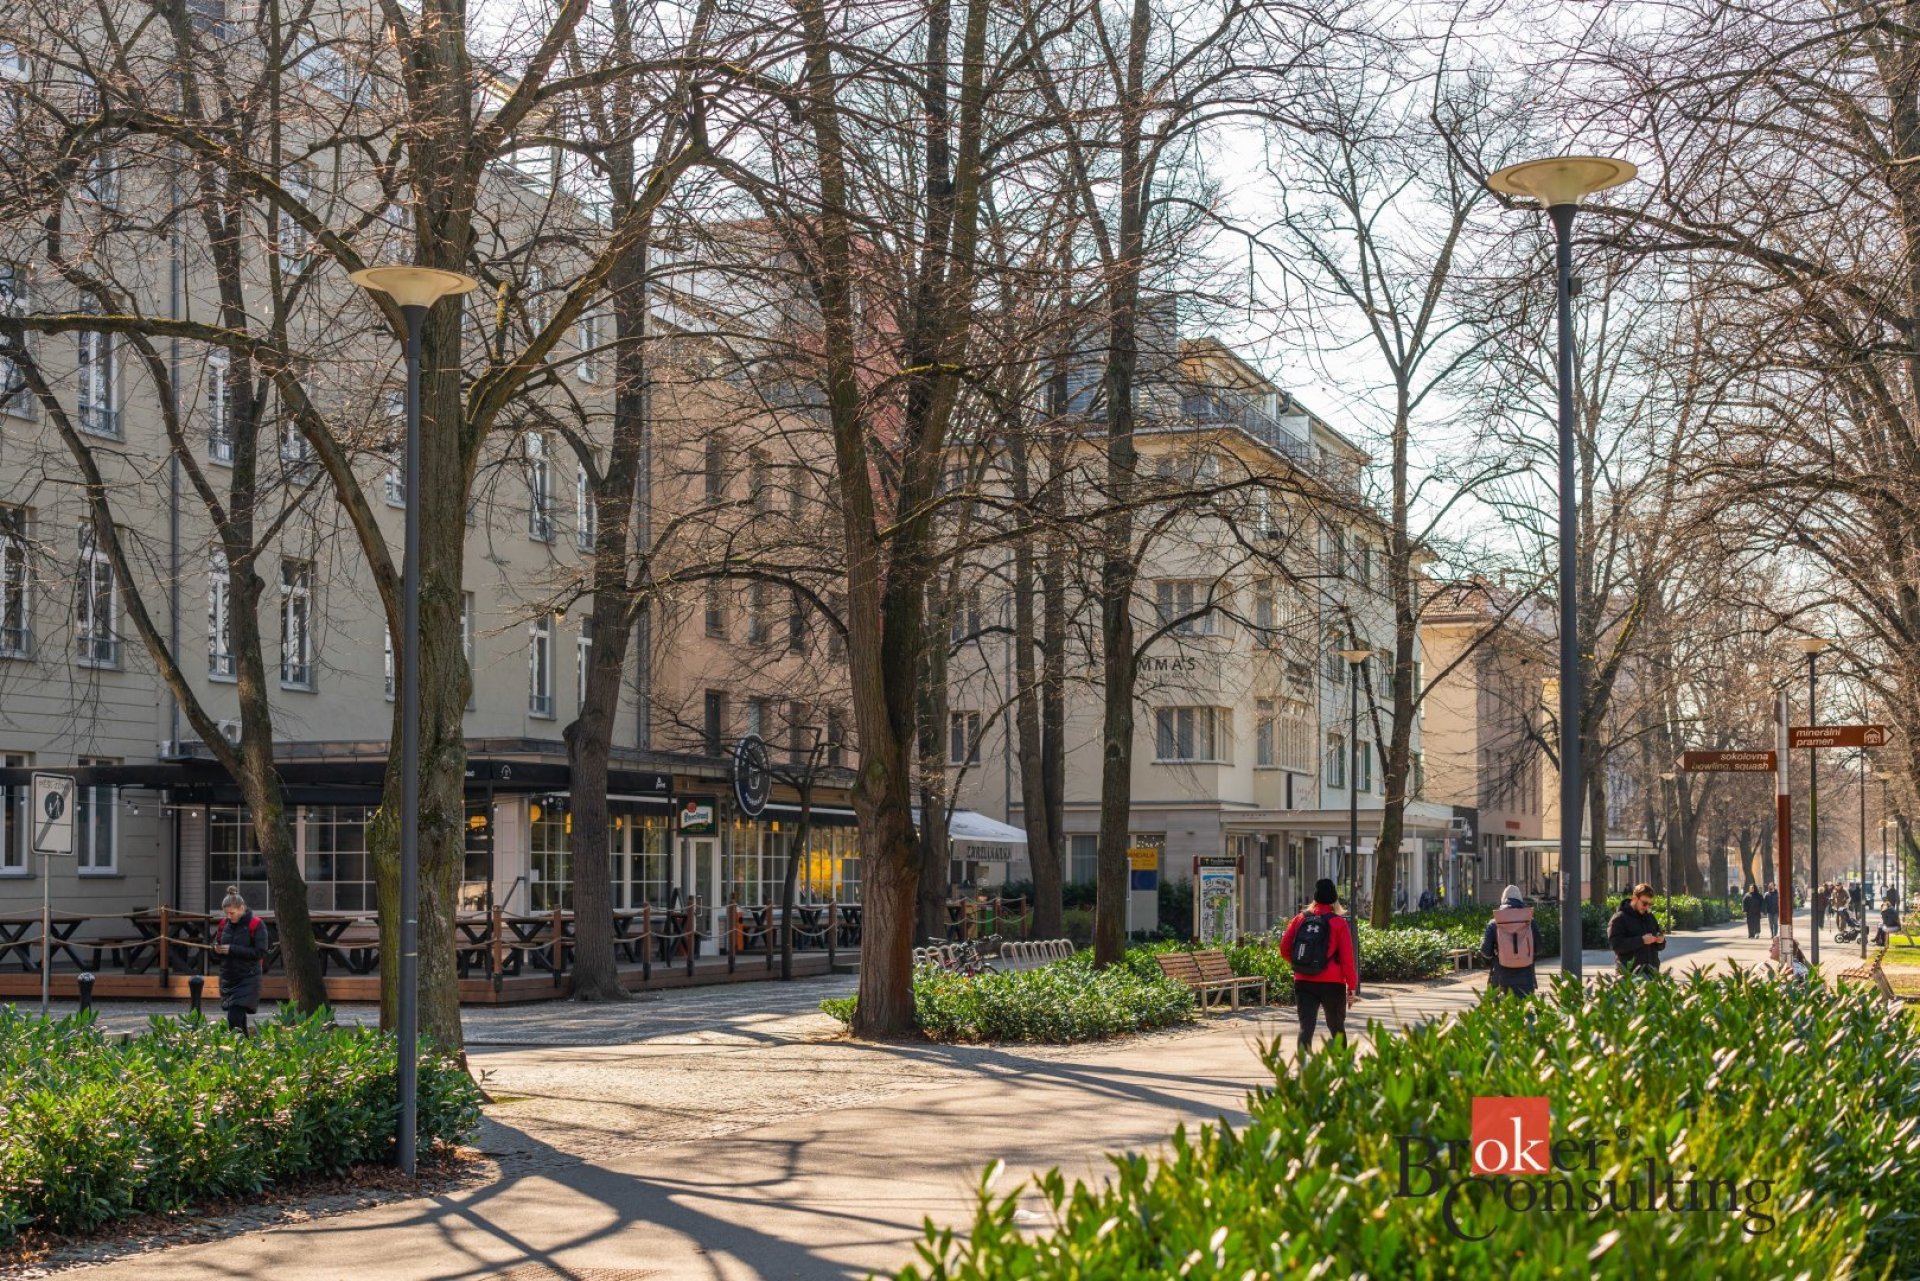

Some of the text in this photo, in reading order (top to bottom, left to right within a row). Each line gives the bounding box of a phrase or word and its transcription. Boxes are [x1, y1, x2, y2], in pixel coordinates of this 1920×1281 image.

[1139, 657, 1196, 670] MMAS
[1796, 727, 1842, 737] minerální
[1796, 738, 1835, 748] pramen
[1720, 752, 1769, 761] sokolovna
[1734, 763, 1769, 771] squash
